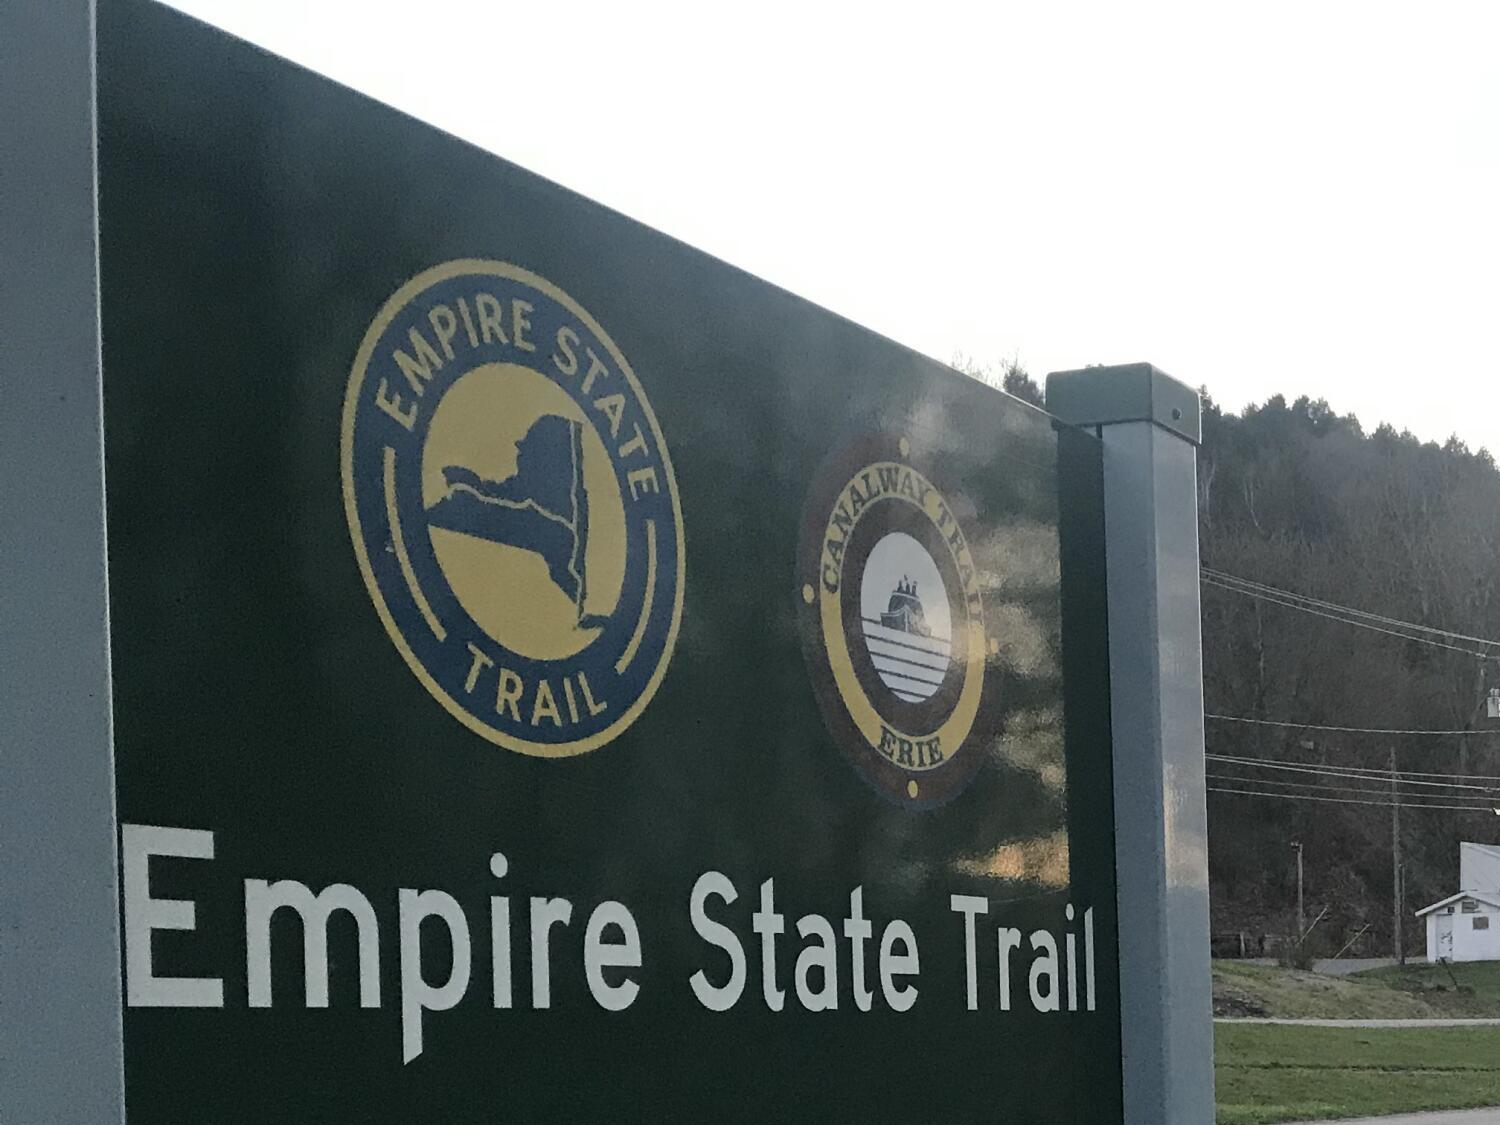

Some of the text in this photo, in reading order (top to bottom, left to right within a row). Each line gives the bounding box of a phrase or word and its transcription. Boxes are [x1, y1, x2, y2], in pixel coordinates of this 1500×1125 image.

[374, 293, 661, 504] EMPIRE STATE
[822, 465, 935, 596] CANALWAY
[464, 643, 608, 729] TRAIL
[875, 724, 946, 768] ERIE
[121, 823, 1098, 1066] Empire State Trail
